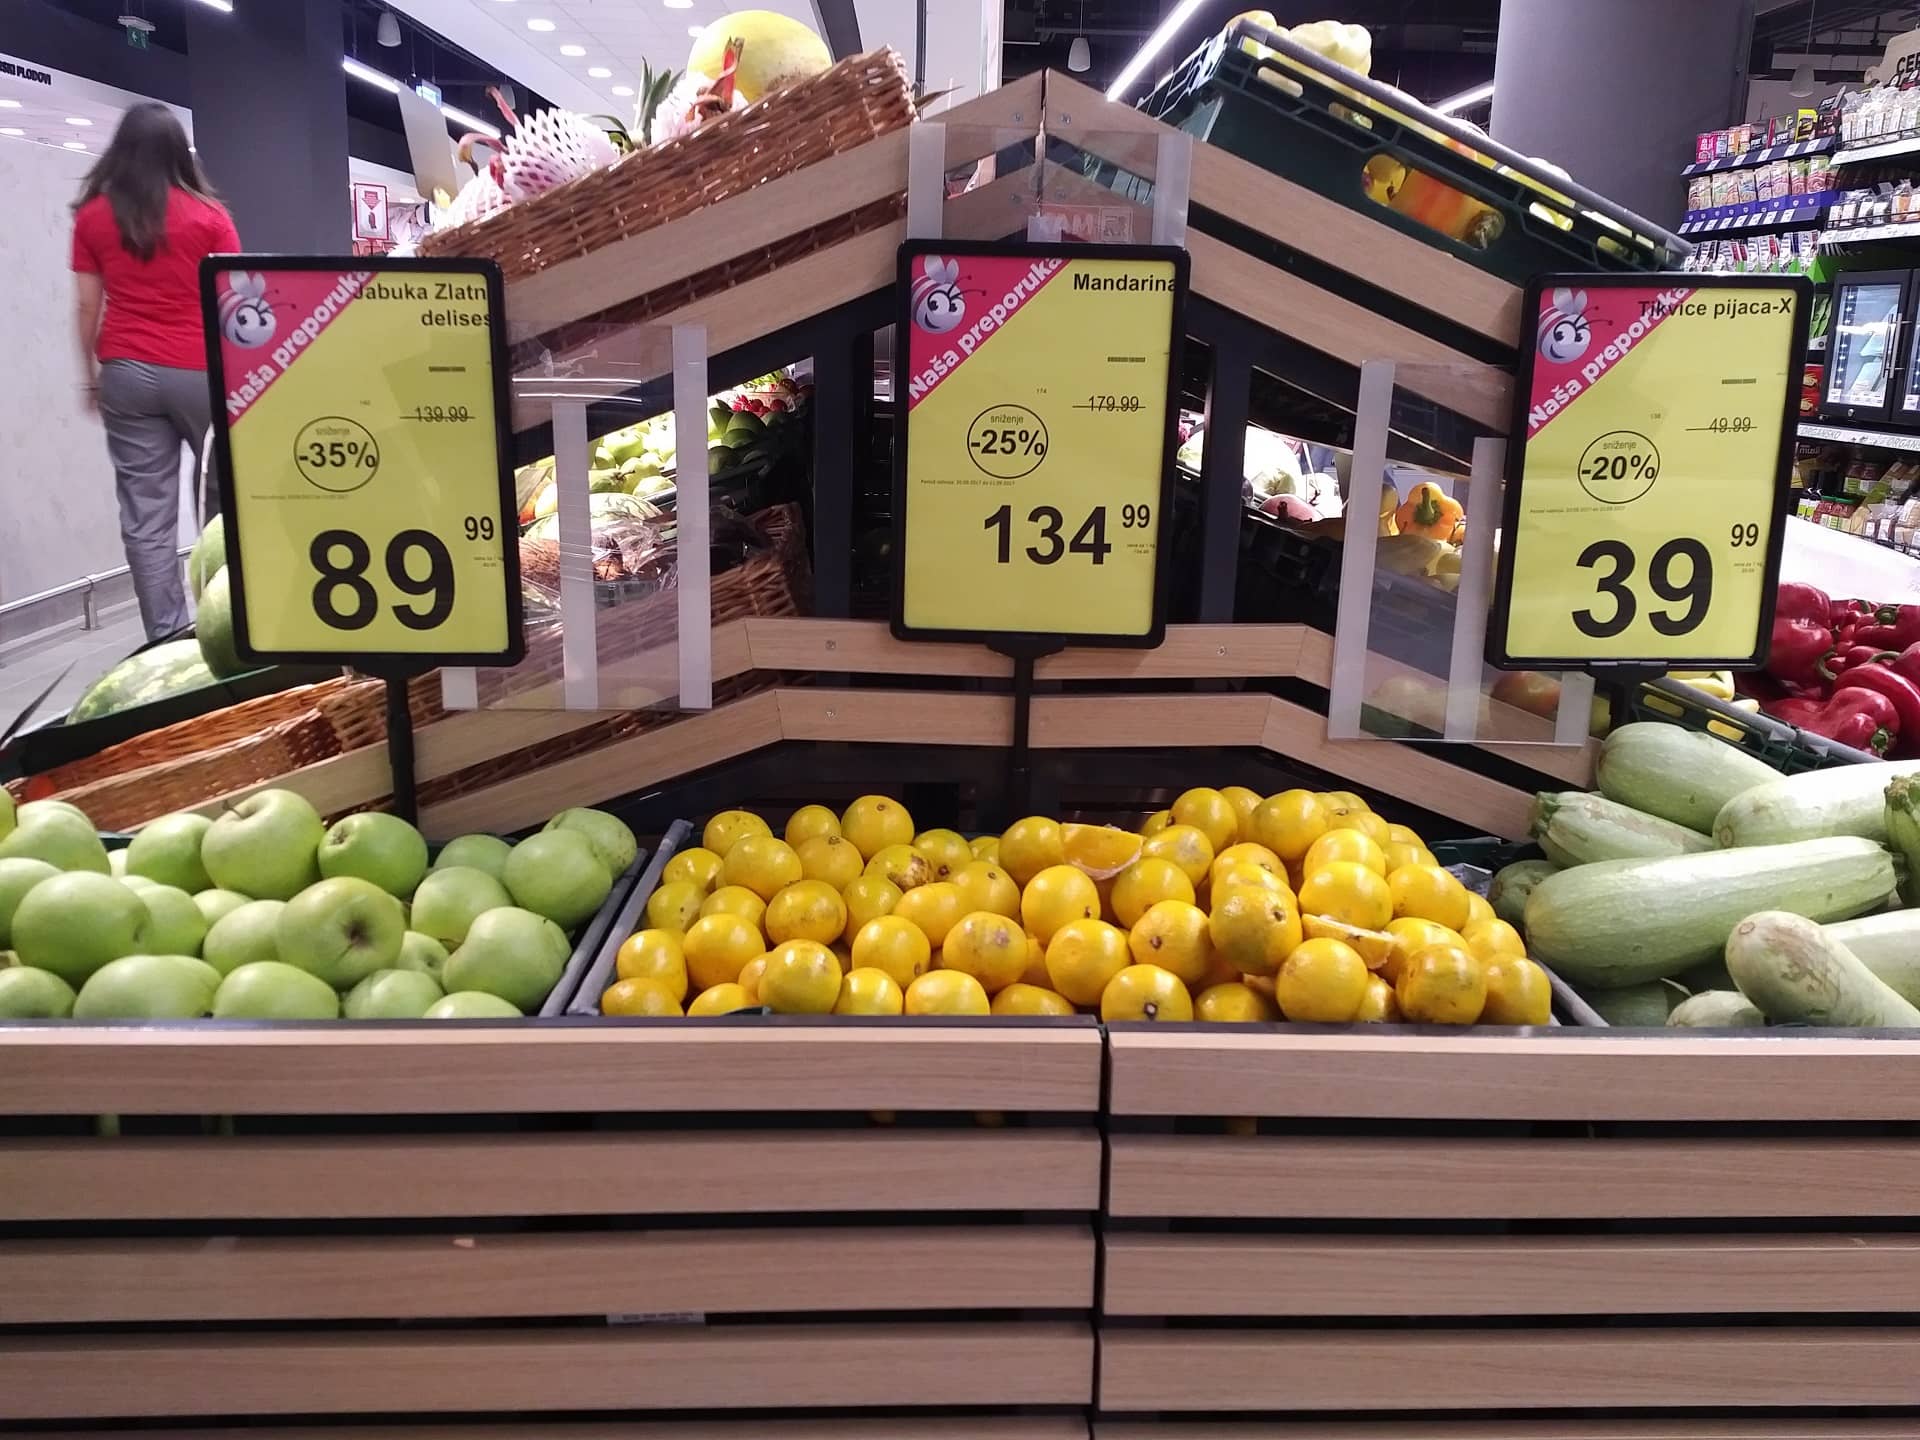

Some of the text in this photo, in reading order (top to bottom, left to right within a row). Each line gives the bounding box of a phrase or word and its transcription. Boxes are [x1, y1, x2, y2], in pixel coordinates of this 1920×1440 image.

[353, 283, 428, 301] Jabuka
[1637, 300, 1707, 317] Tikvice
[908, 257, 1064, 400] Naša preporuka
[226, 271, 373, 417] Naša preporuka
[414, 405, 470, 424] 139.99
[1087, 395, 1140, 413] 179.99
[1527, 380, 1583, 430] Naša
[989, 414, 1024, 425] sniženje
[1708, 417, 1752, 434] 49.99
[298, 441, 378, 469] -35%
[970, 430, 1046, 456] -25%
[1602, 440, 1637, 450] sniženje
[1581, 454, 1656, 480] -20%
[464, 516, 495, 541] 99
[1121, 504, 1150, 529] 99
[984, 504, 1112, 566] 134
[1730, 523, 1760, 548] 99
[309, 529, 456, 632] 89
[1571, 537, 1713, 639] 39
